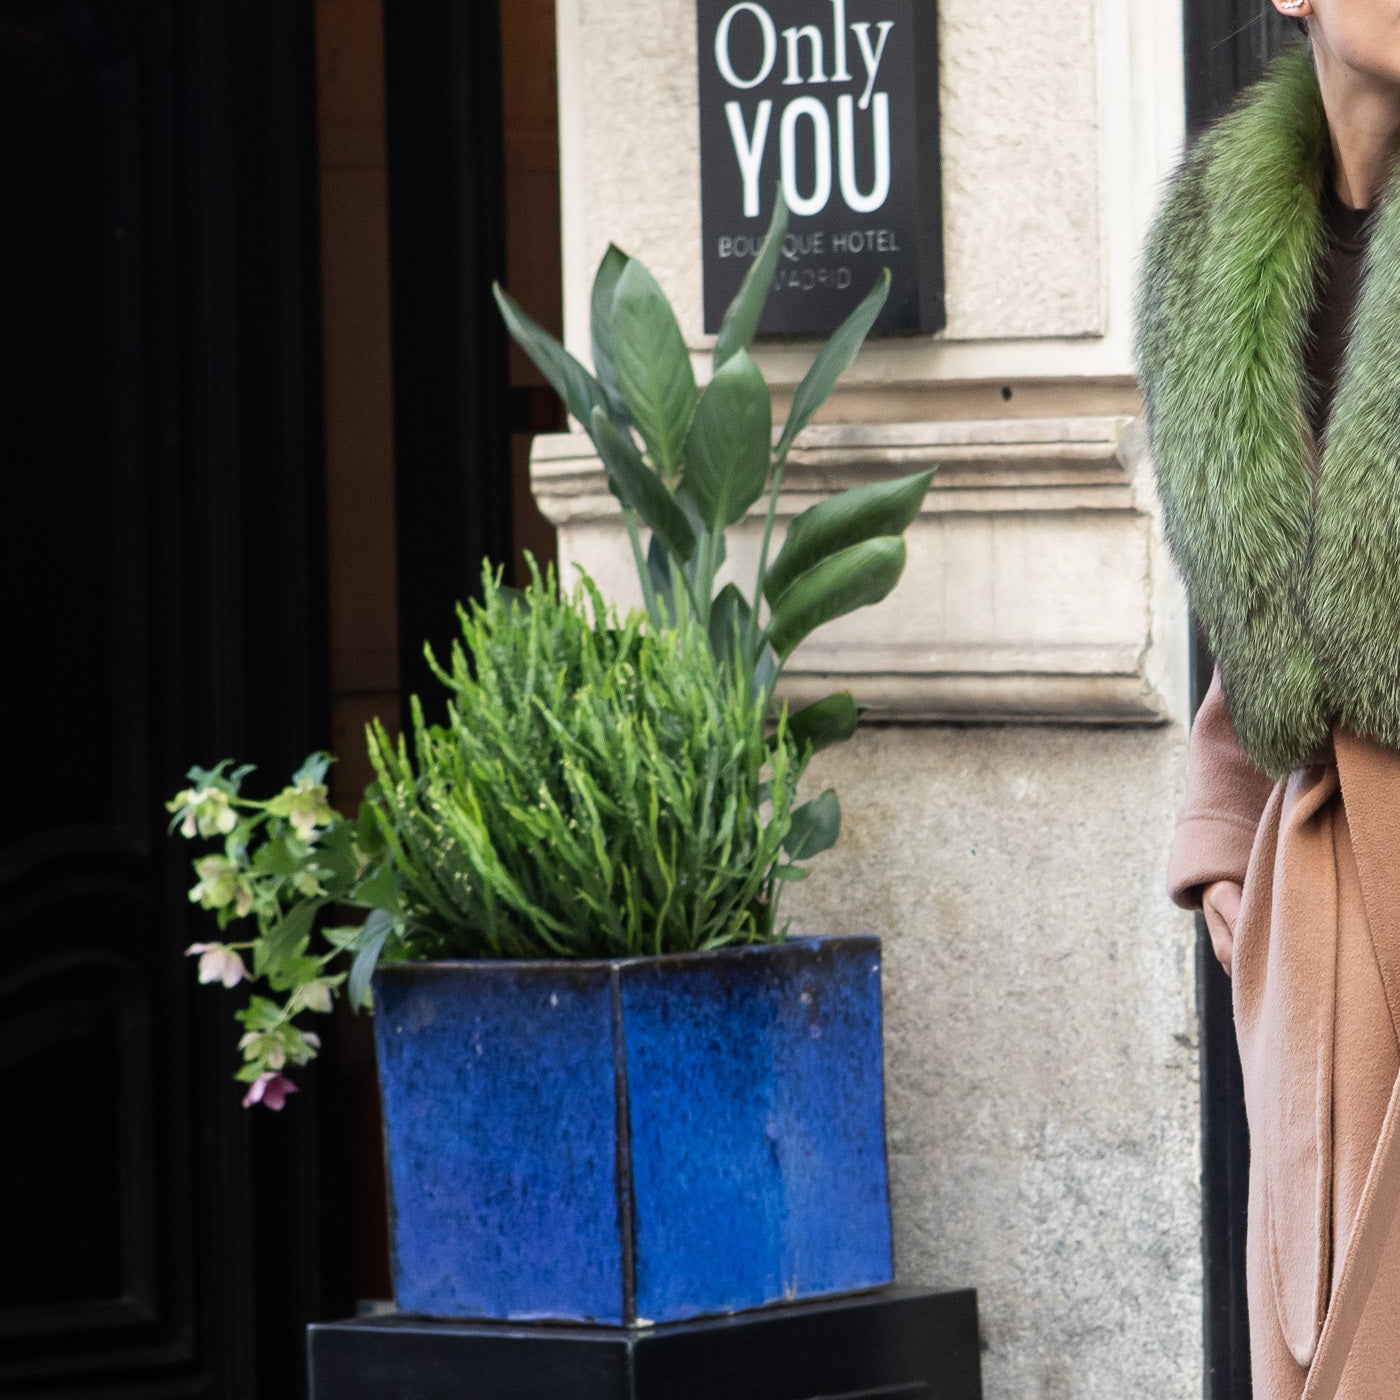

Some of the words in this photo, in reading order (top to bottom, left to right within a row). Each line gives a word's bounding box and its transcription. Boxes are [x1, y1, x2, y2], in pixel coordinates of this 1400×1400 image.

[724, 92, 891, 218] YOU
[717, 231, 825, 262] BOUQUE
[832, 229, 900, 255] HOTEL
